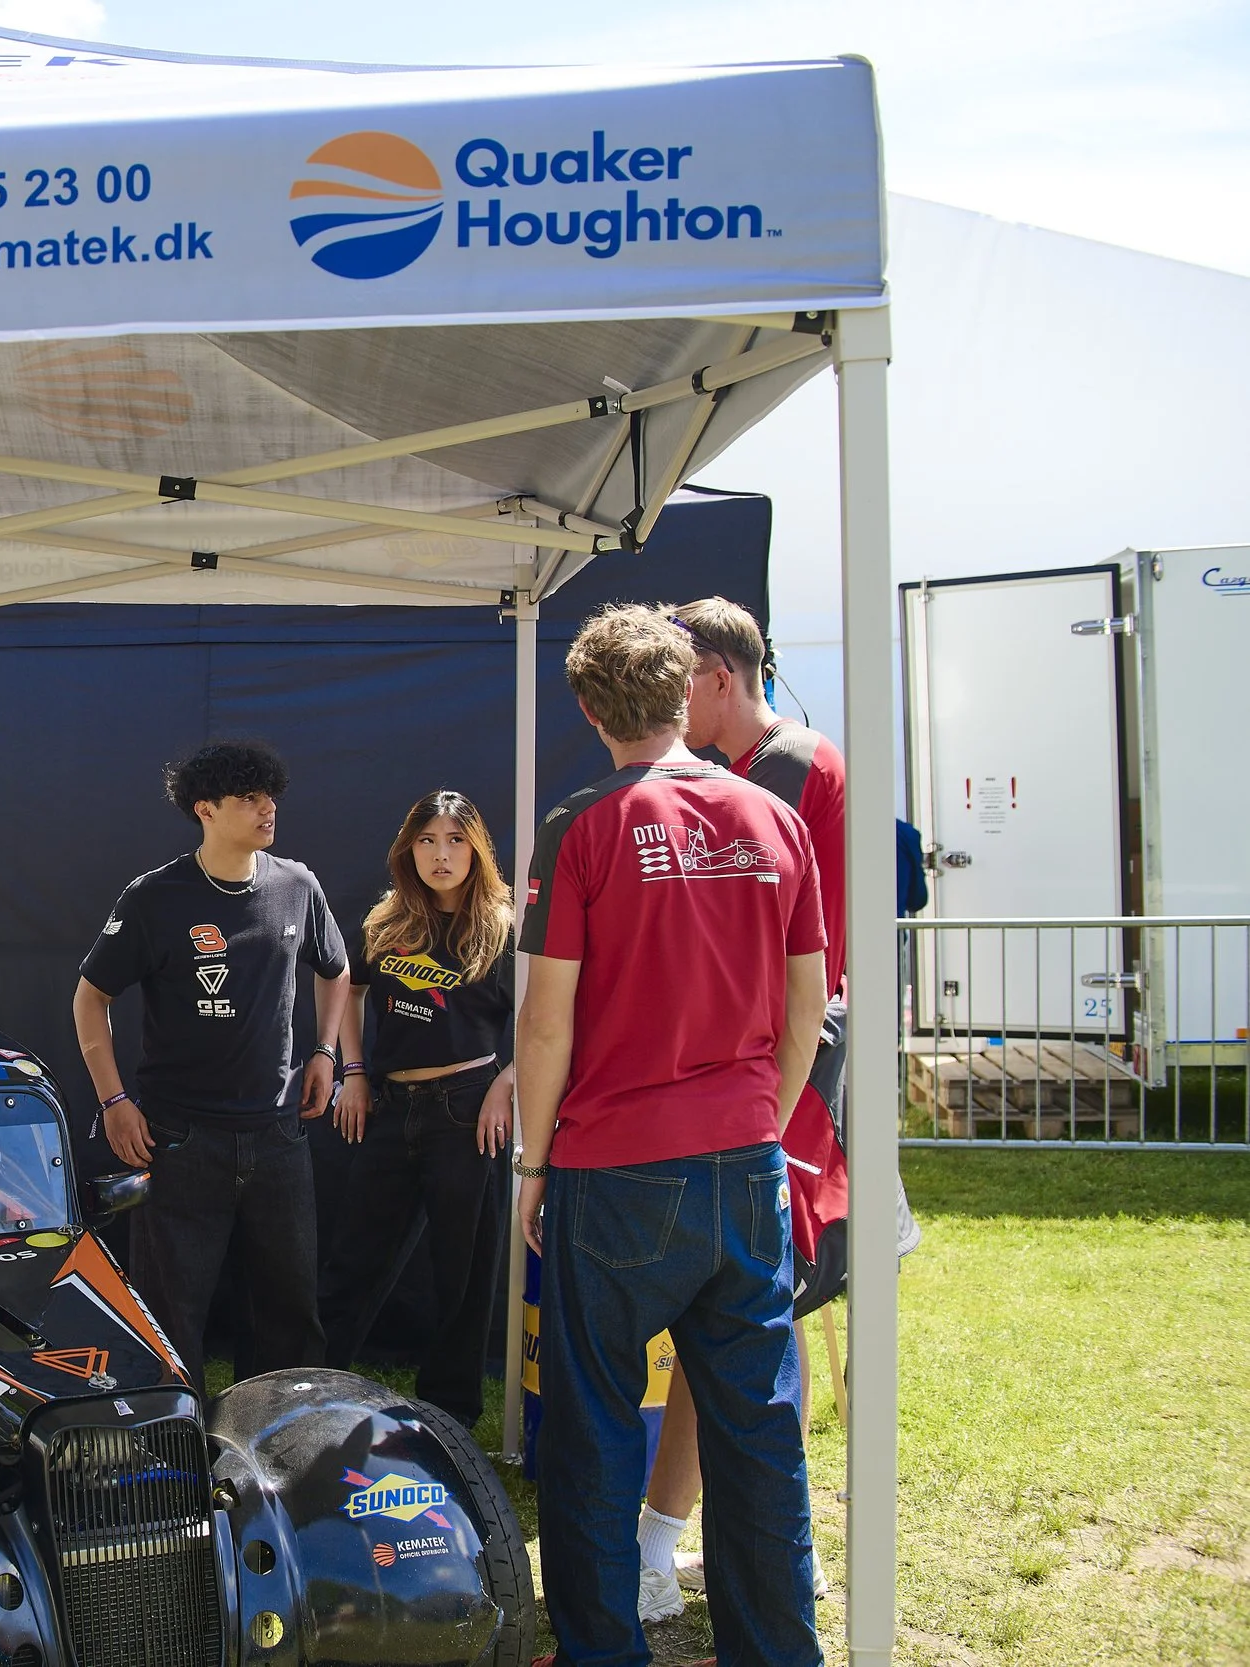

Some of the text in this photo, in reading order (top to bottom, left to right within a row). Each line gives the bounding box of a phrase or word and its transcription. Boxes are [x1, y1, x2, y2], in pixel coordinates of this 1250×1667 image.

[455, 130, 693, 188] Quaker
[24, 168, 79, 208] 23
[96, 163, 152, 204] 00
[457, 189, 762, 259] Houghton
[632, 823, 668, 846] DTU
[189, 923, 228, 954] 3
[381, 957, 459, 988] SUNOCO
[395, 999, 434, 1018] KEMATEK
[1084, 997, 1112, 1018] 25
[352, 1485, 444, 1516] SUNOCO
[396, 1536, 447, 1552] KEMATEK
